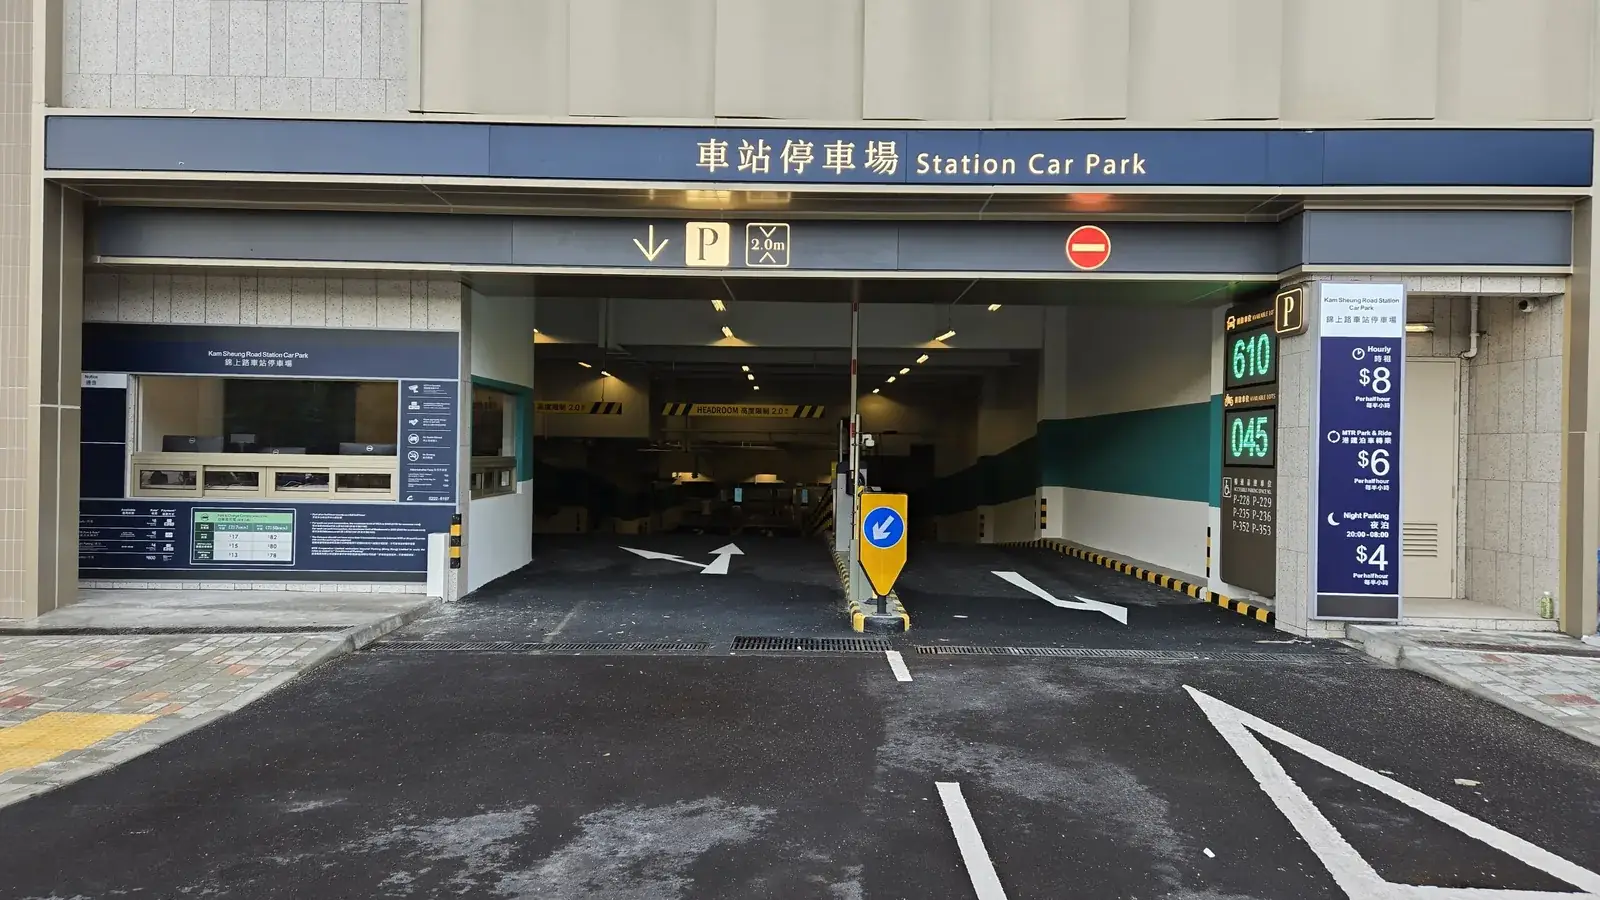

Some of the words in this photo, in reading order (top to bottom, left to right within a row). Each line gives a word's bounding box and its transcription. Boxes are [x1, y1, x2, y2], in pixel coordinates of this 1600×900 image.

[695, 139, 899, 175] 車站停車場
[916, 152, 1016, 176] Station
[1028, 152, 1074, 176] Car
[1086, 152, 1147, 176] Park
[697, 227, 719, 261] P
[750, 239, 785, 251] 2.0m
[1283, 296, 1295, 327] P
[1326, 316, 1397, 324] 錦上路車站停車場
[1233, 333, 1270, 379] 610
[1367, 346, 1392, 354] Hourly
[1374, 355, 1391, 363] 時租
[1359, 366, 1391, 394] $8
[697, 406, 739, 414] HEADROOM
[771, 407, 783, 415] 2.0
[1231, 417, 1268, 457] 045
[1358, 448, 1390, 476] $6
[1233, 494, 1250, 505] P-228
[1252, 496, 1271, 507] P-229
[1233, 507, 1250, 519] P-235
[1252, 509, 1271, 522] P-236
[1343, 512, 1362, 520] Night
[1363, 512, 1390, 520] Parking
[1232, 520, 1250, 533] P-352
[1252, 523, 1271, 536] P-353
[1370, 521, 1389, 529] 夜泊
[1356, 544, 1389, 571] $4
